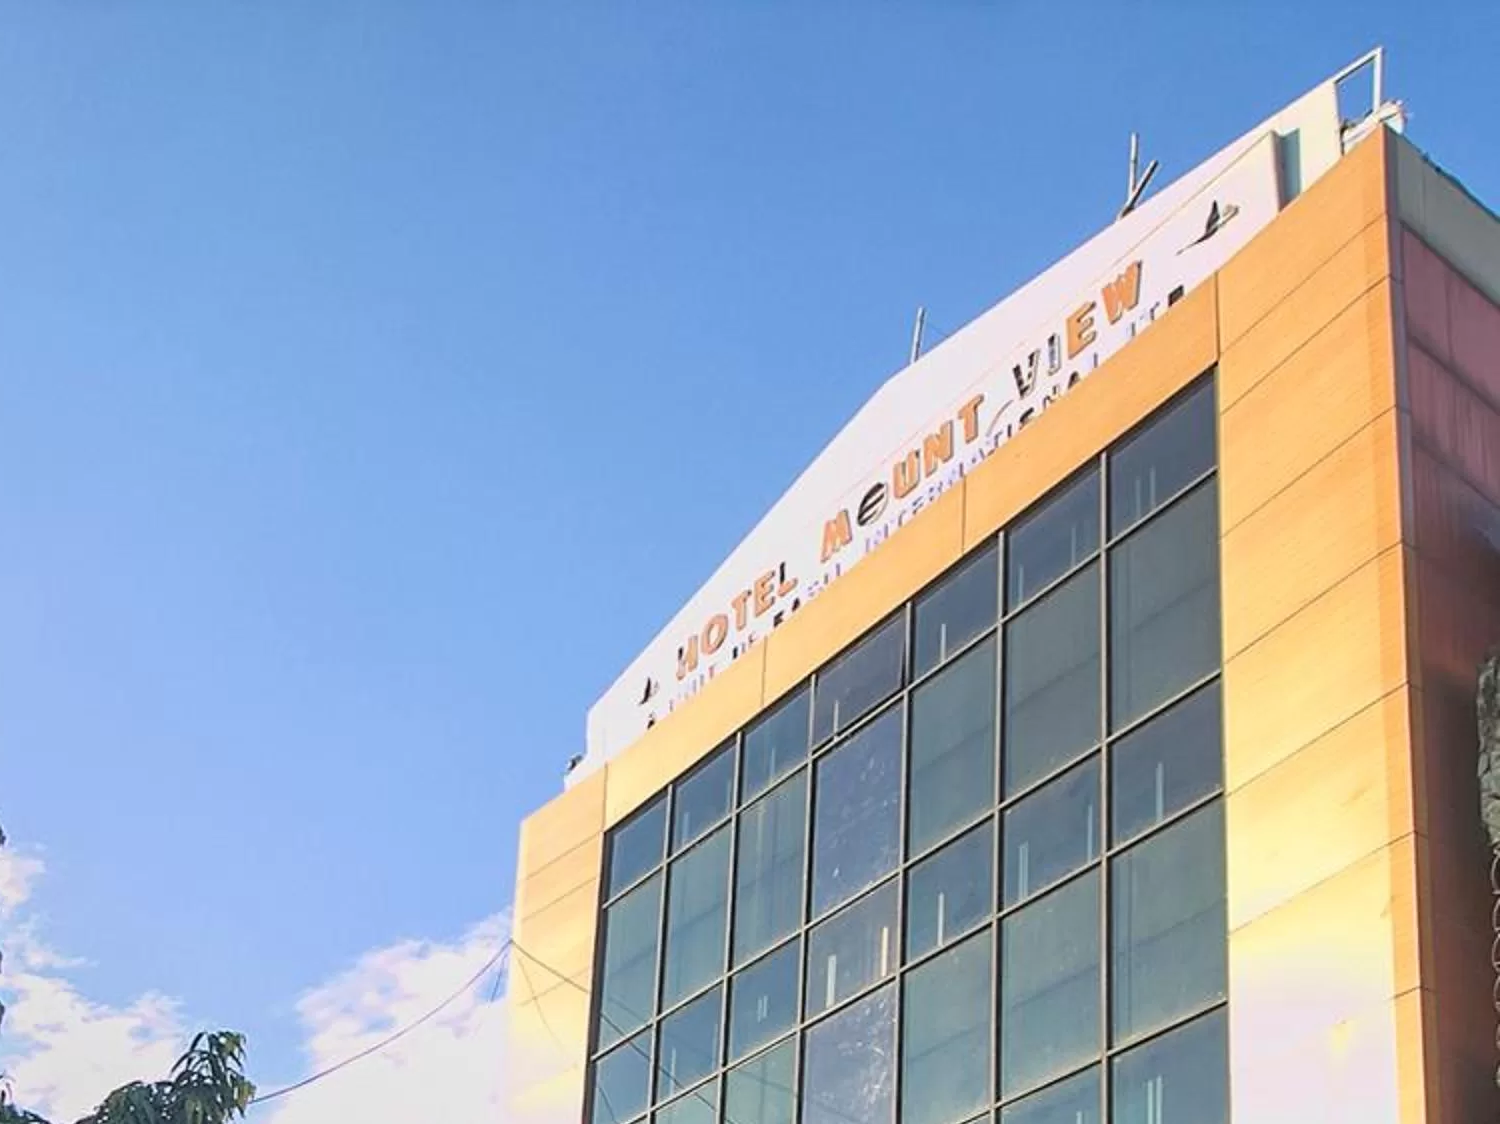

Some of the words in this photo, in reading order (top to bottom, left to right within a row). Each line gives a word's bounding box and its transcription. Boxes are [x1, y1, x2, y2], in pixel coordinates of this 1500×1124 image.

[675, 560, 799, 681] HOTEL
[819, 393, 986, 564] MOUNT
[1012, 259, 1143, 398] VIEW
